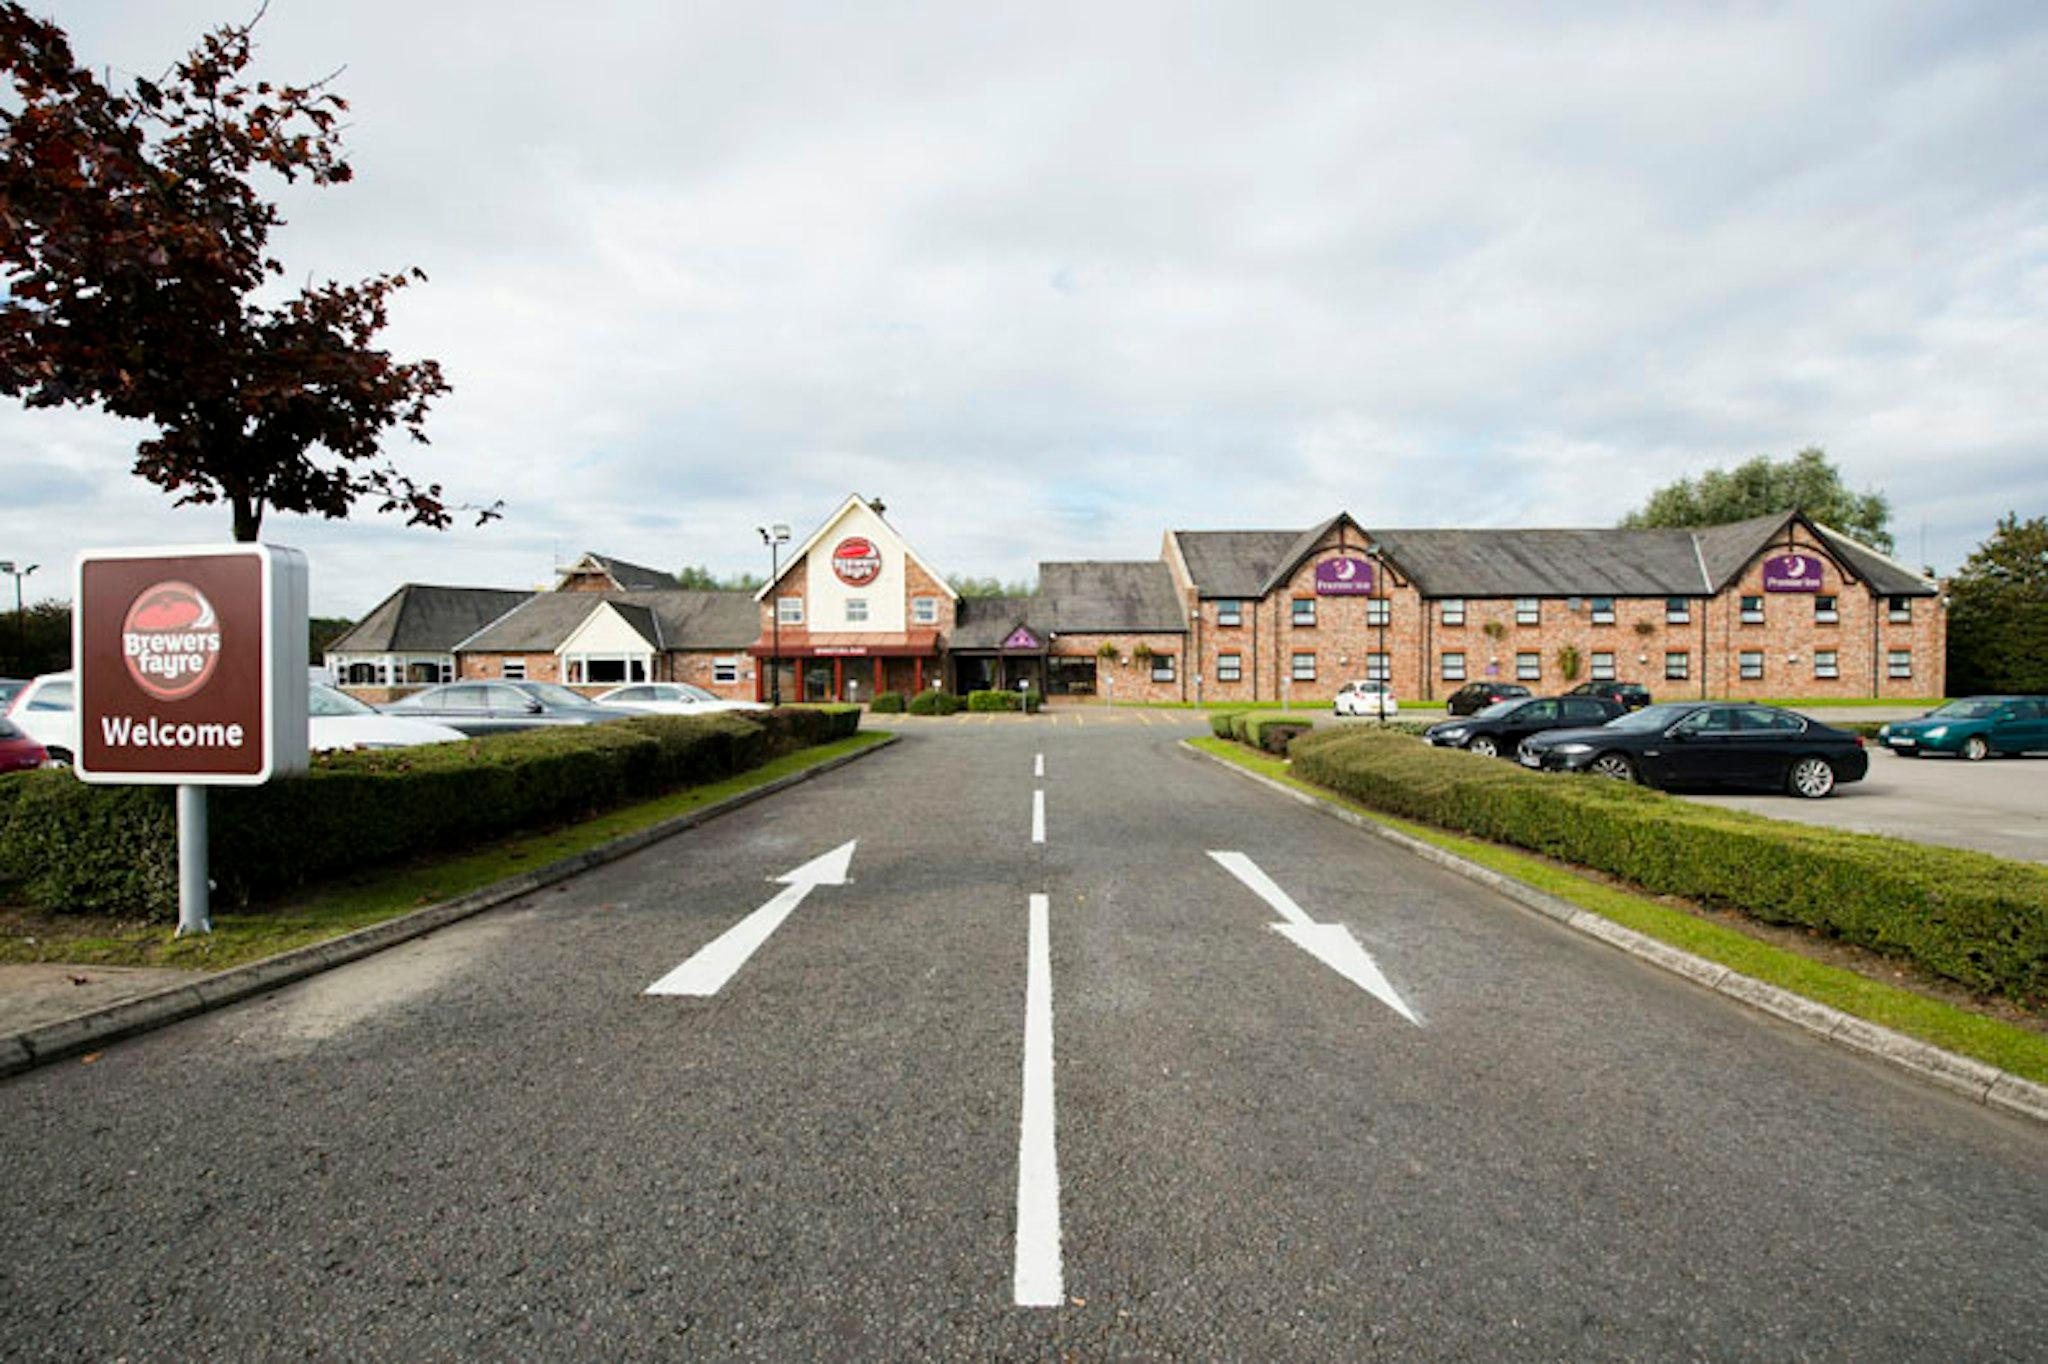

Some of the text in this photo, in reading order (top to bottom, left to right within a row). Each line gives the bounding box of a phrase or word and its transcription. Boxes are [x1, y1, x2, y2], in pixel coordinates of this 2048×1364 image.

[122, 633, 220, 656] Brewers
[138, 648, 204, 679] fayre
[101, 715, 244, 748] Welcome
